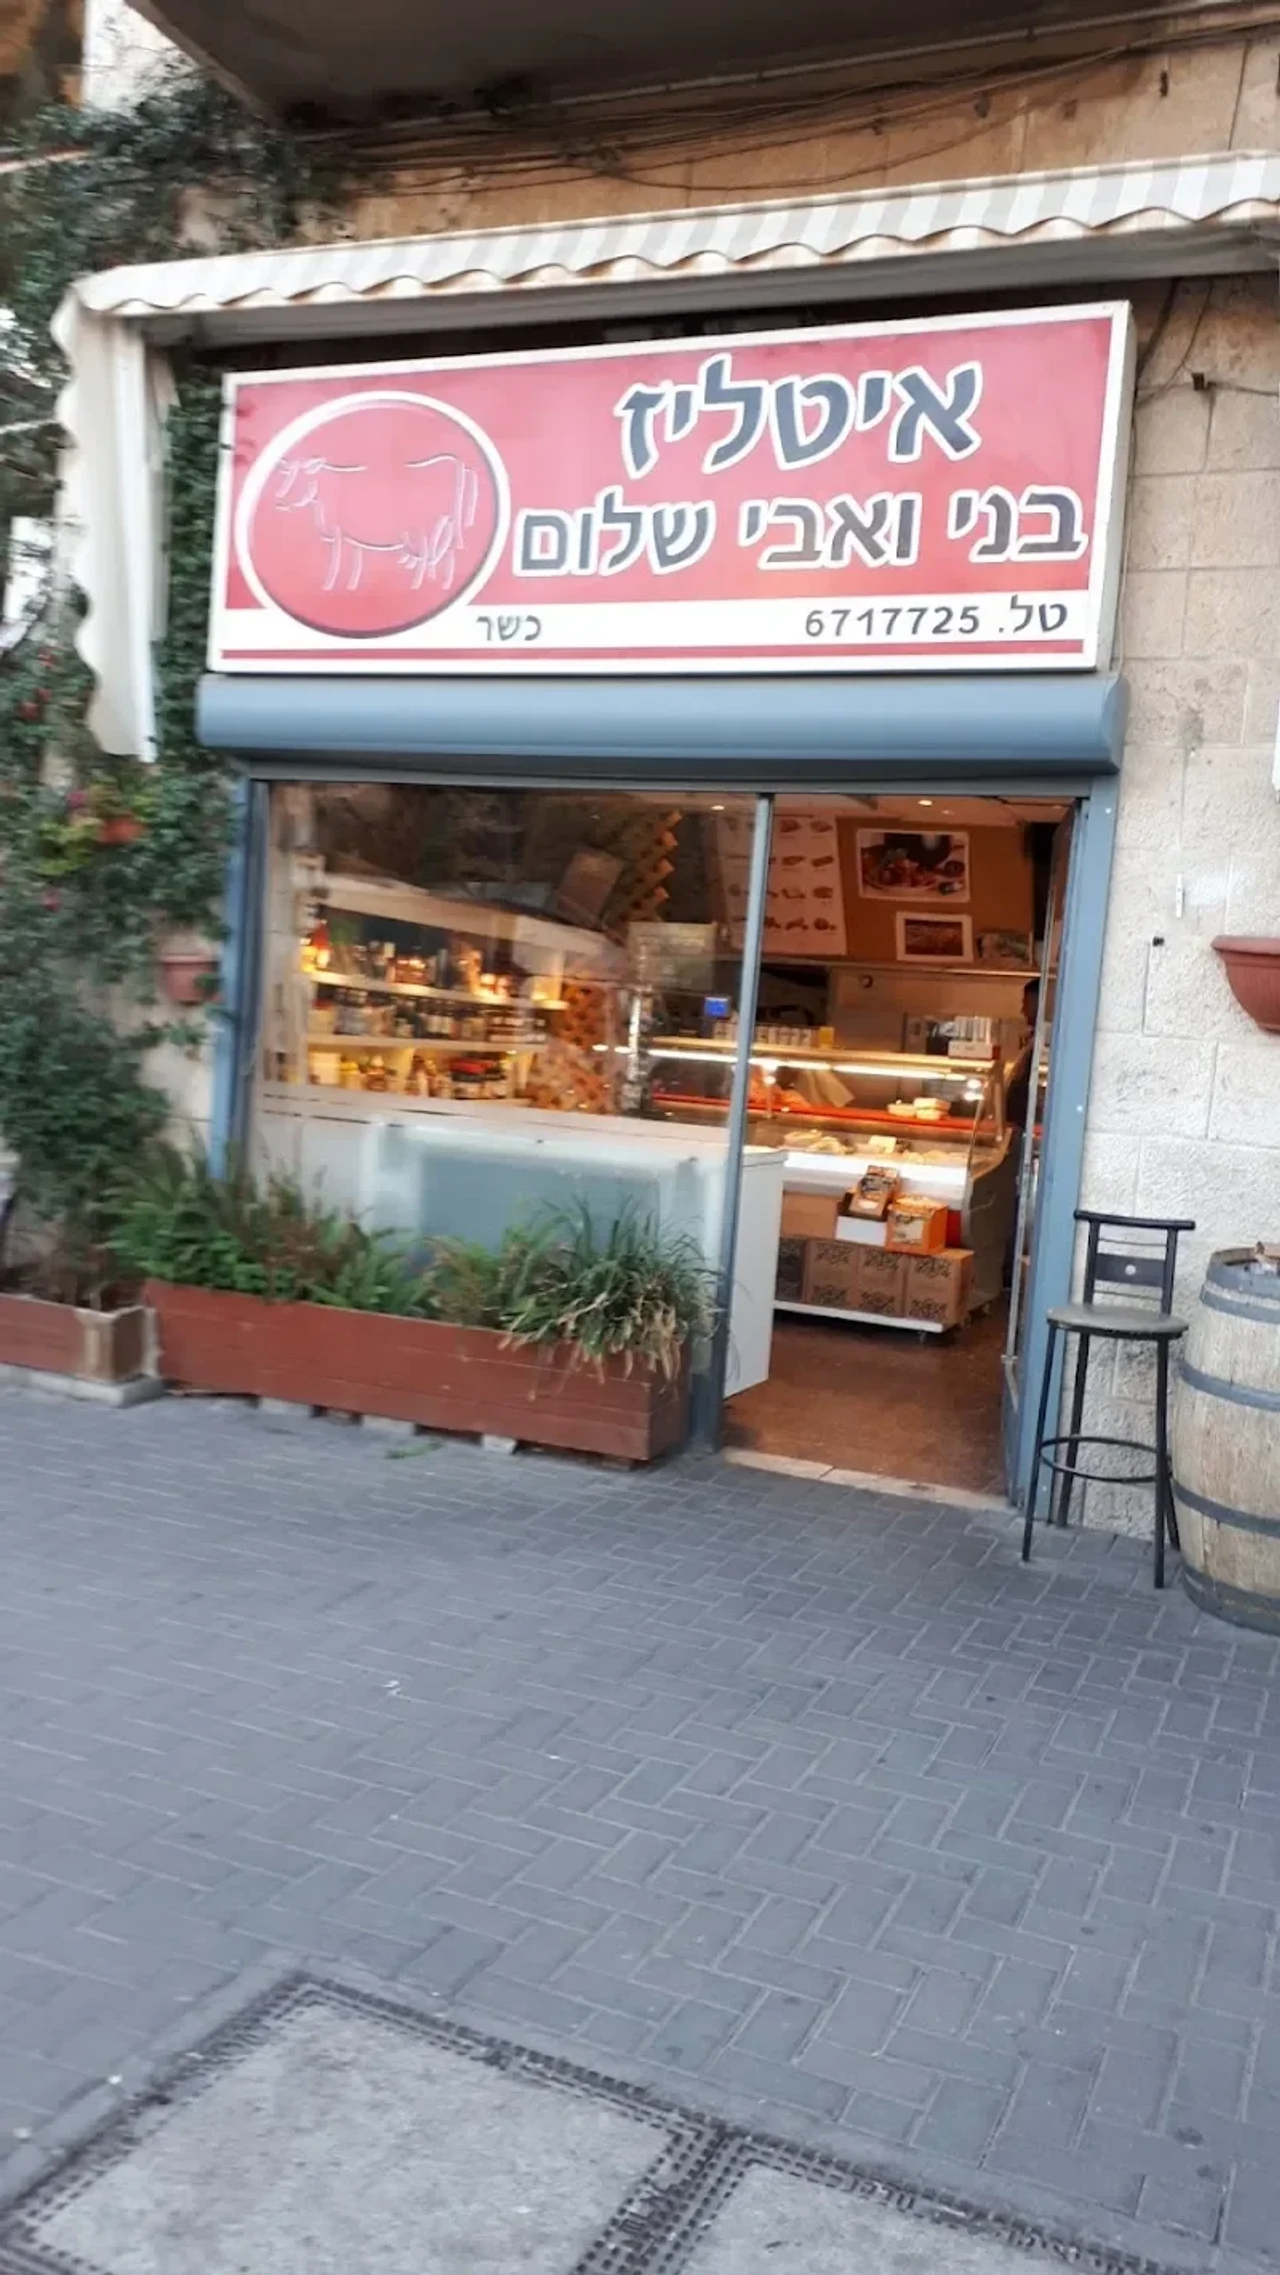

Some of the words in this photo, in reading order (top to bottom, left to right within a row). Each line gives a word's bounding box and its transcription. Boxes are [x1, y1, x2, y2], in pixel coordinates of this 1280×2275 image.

[618, 355, 979, 476] איטליז
[517, 488, 712, 573] שלום
[742, 494, 918, 567] ואבי
[951, 489, 1085, 560] בני
[476, 614, 542, 641] כשר
[805, 605, 980, 637] 6717725
[998, 594, 1068, 633] טל.
